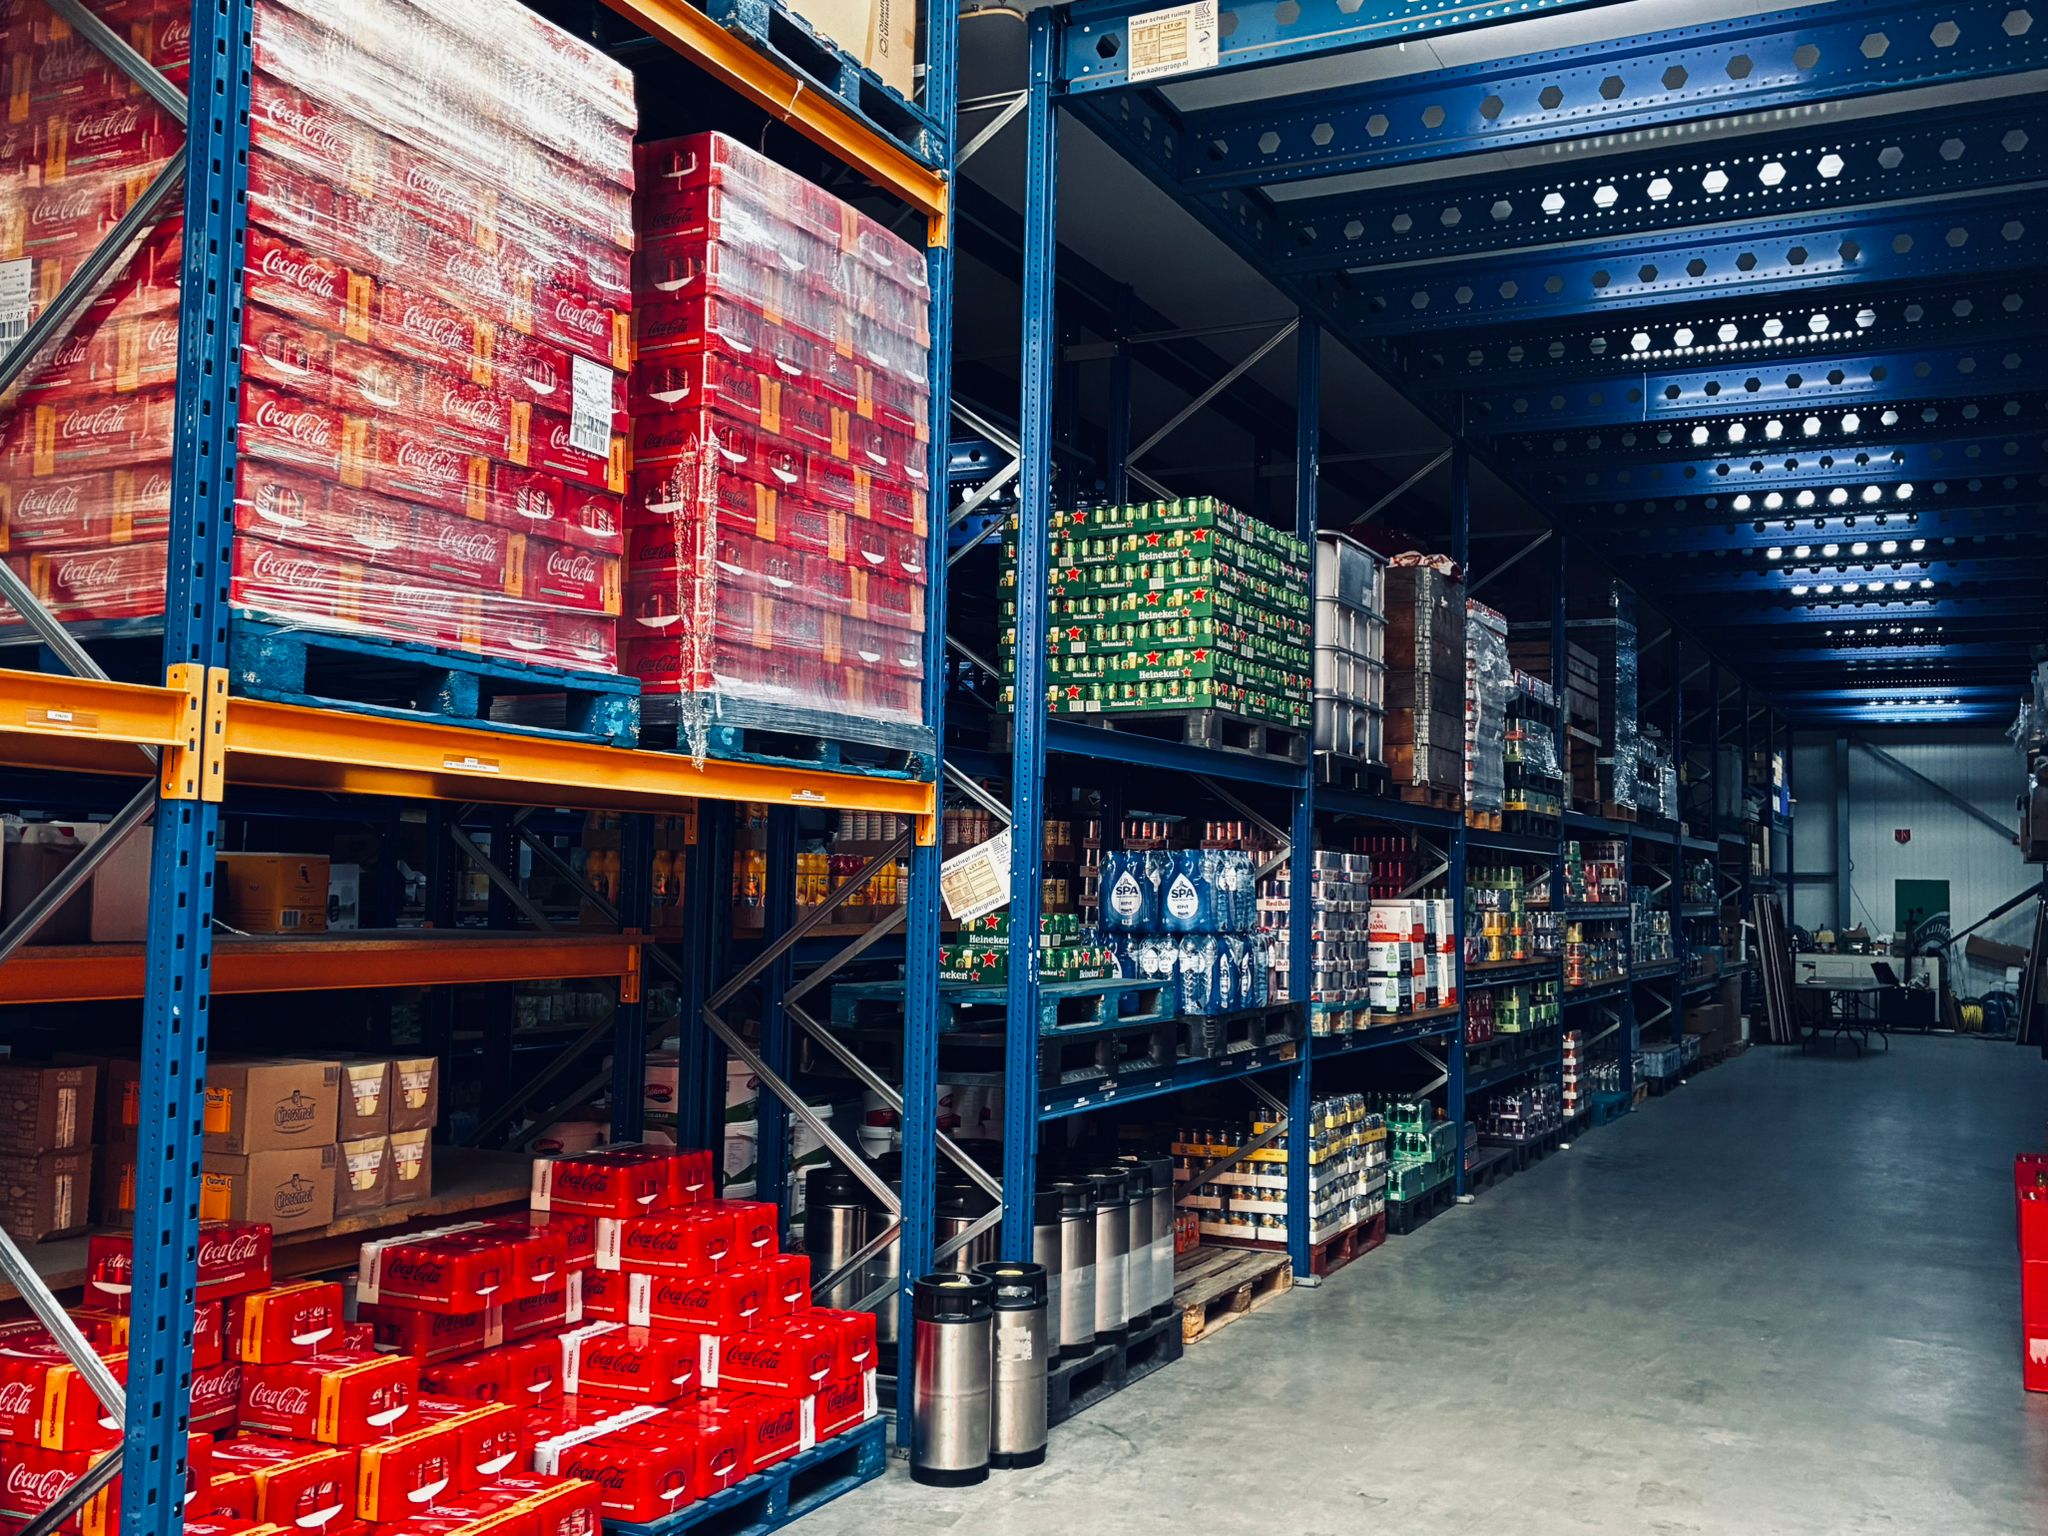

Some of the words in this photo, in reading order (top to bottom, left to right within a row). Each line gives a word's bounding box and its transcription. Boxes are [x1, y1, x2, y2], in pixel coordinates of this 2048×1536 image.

[262, 248, 337, 298] Coca-Cola
[403, 305, 467, 348] Coca-Cola
[555, 299, 606, 336] Coca-Cola
[63, 405, 130, 438] Coca-Cola
[256, 401, 331, 446] Coca-Cola
[443, 390, 503, 430] Coca-Cola
[398, 442, 462, 481] Coca-Cola
[18, 485, 82, 518] Coca-Cola
[440, 525, 499, 562] Coca-Cola
[1138, 550, 1179, 562] Heineken
[57, 556, 126, 587] Coca-Cola
[547, 551, 597, 582] Coca-Cola
[1138, 610, 1179, 620] Heineken
[1138, 670, 1180, 680] Heineken
[1115, 886, 1138, 896] SPA
[1171, 889, 1194, 899] SPA
[969, 934, 1010, 945] Heineken
[558, 1170, 609, 1193] Coca-Cola
[197, 1232, 260, 1268] Coca-Cola
[626, 1229, 682, 1251] Coca-Cola
[387, 1257, 446, 1284] Coca-Cola
[657, 1285, 713, 1309] Coca-Cola
[586, 1349, 645, 1374] Coca-Cola
[726, 1345, 782, 1369] Coca-Cola
[249, 1381, 311, 1415] Coca-Cola
[758, 1408, 794, 1444] Coca-Cola
[565, 1460, 629, 1491] Coca-Cola
